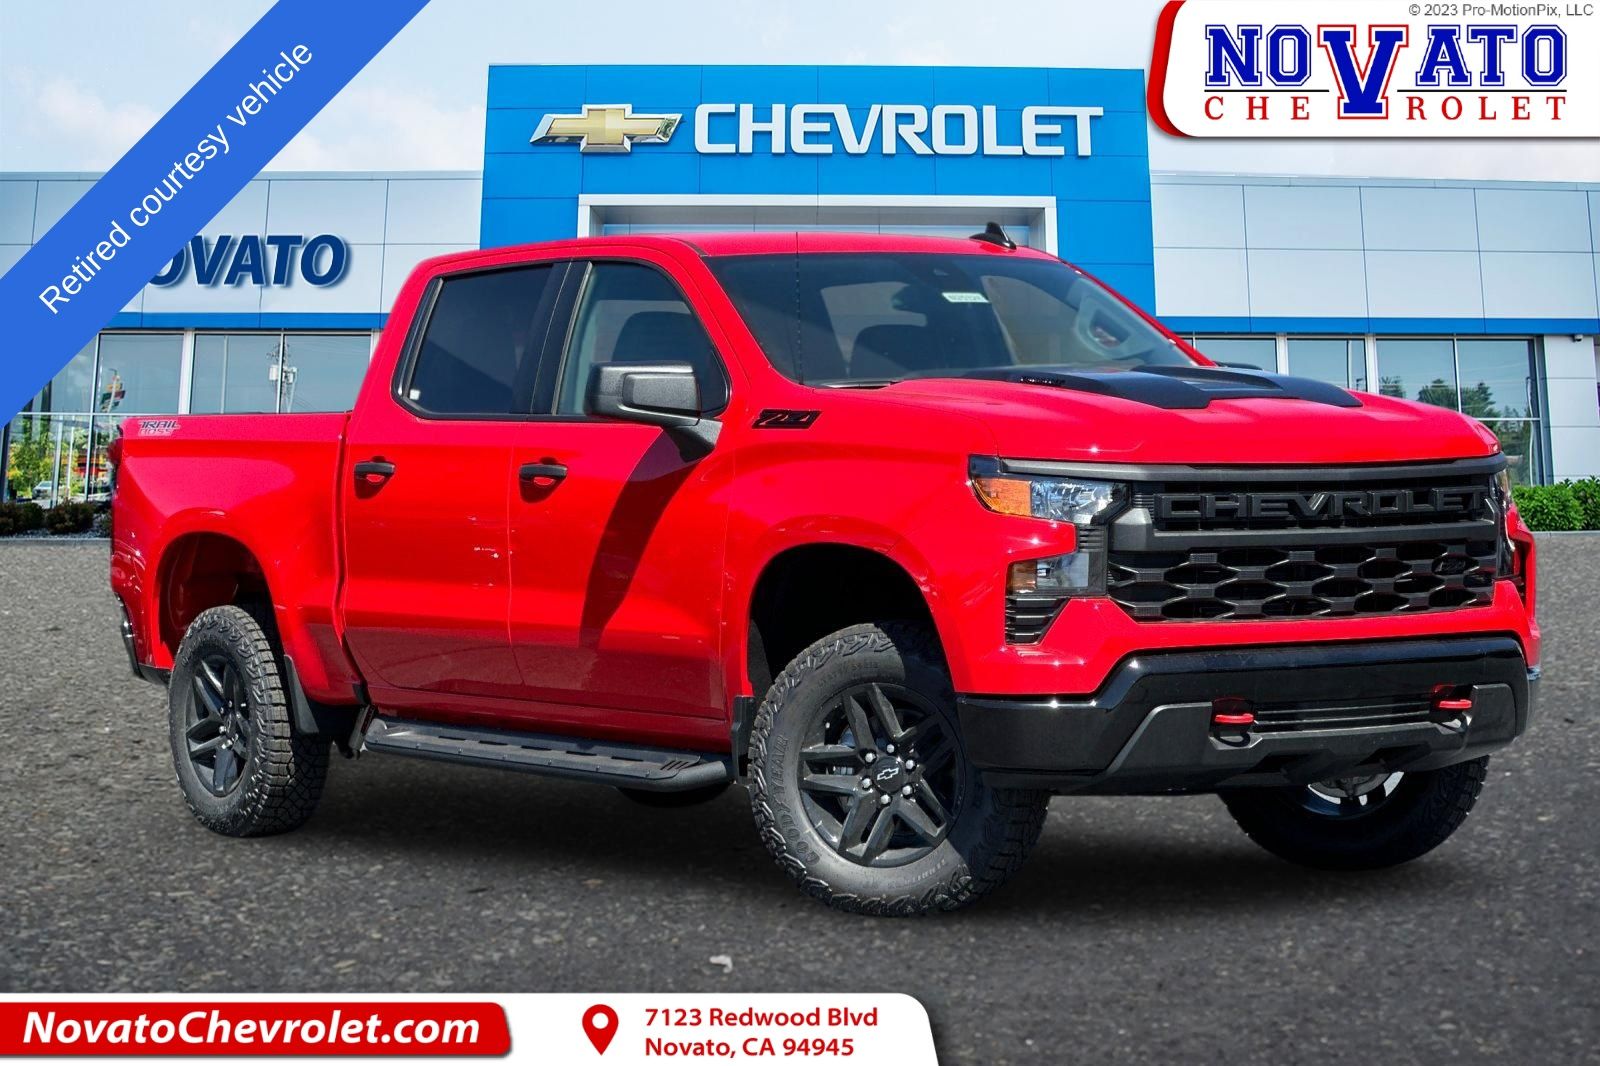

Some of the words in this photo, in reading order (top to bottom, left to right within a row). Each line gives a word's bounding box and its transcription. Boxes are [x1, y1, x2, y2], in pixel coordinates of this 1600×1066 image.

[694, 103, 1104, 157] CHEVROLET
[148, 234, 349, 287] OVATO
[139, 420, 180, 429] TRAIL
[1153, 486, 1488, 519] CHEVROLET
